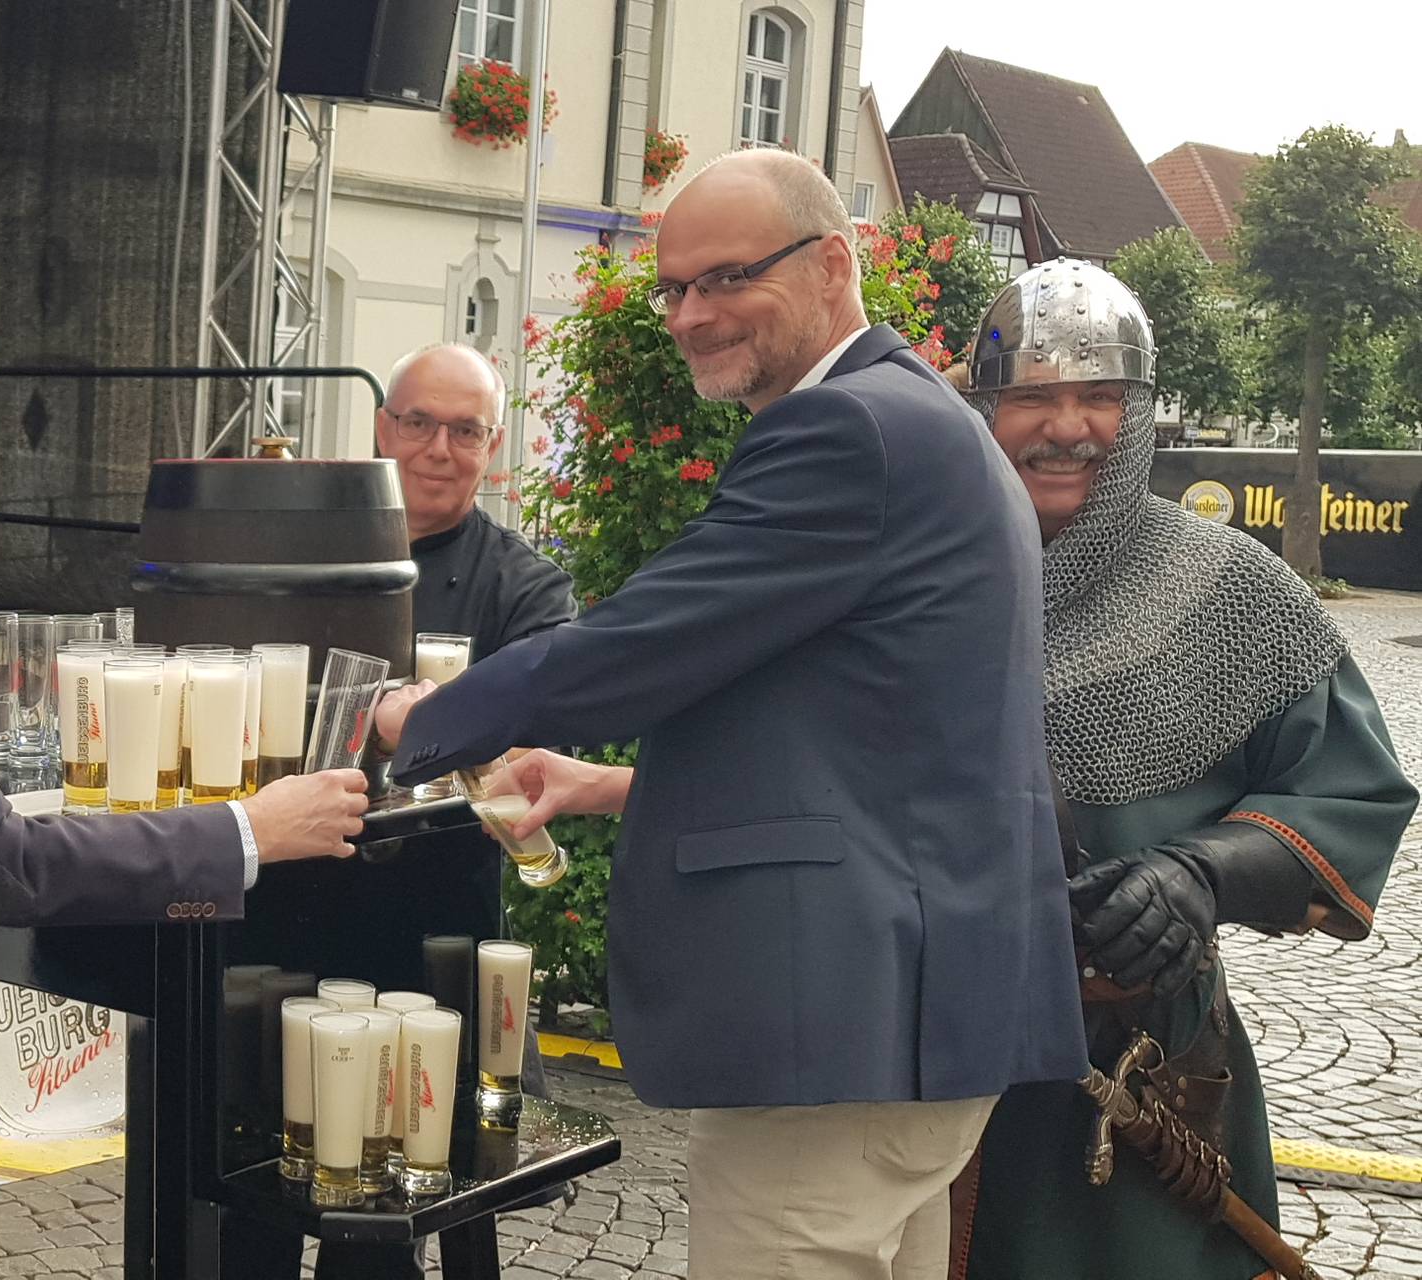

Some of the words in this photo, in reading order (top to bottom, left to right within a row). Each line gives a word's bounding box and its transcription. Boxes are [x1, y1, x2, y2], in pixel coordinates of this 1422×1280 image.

[1244, 483, 1410, 536] Wateiner
[15, 1003, 111, 1071] BURG
[25, 1029, 117, 1113] Pilsener
